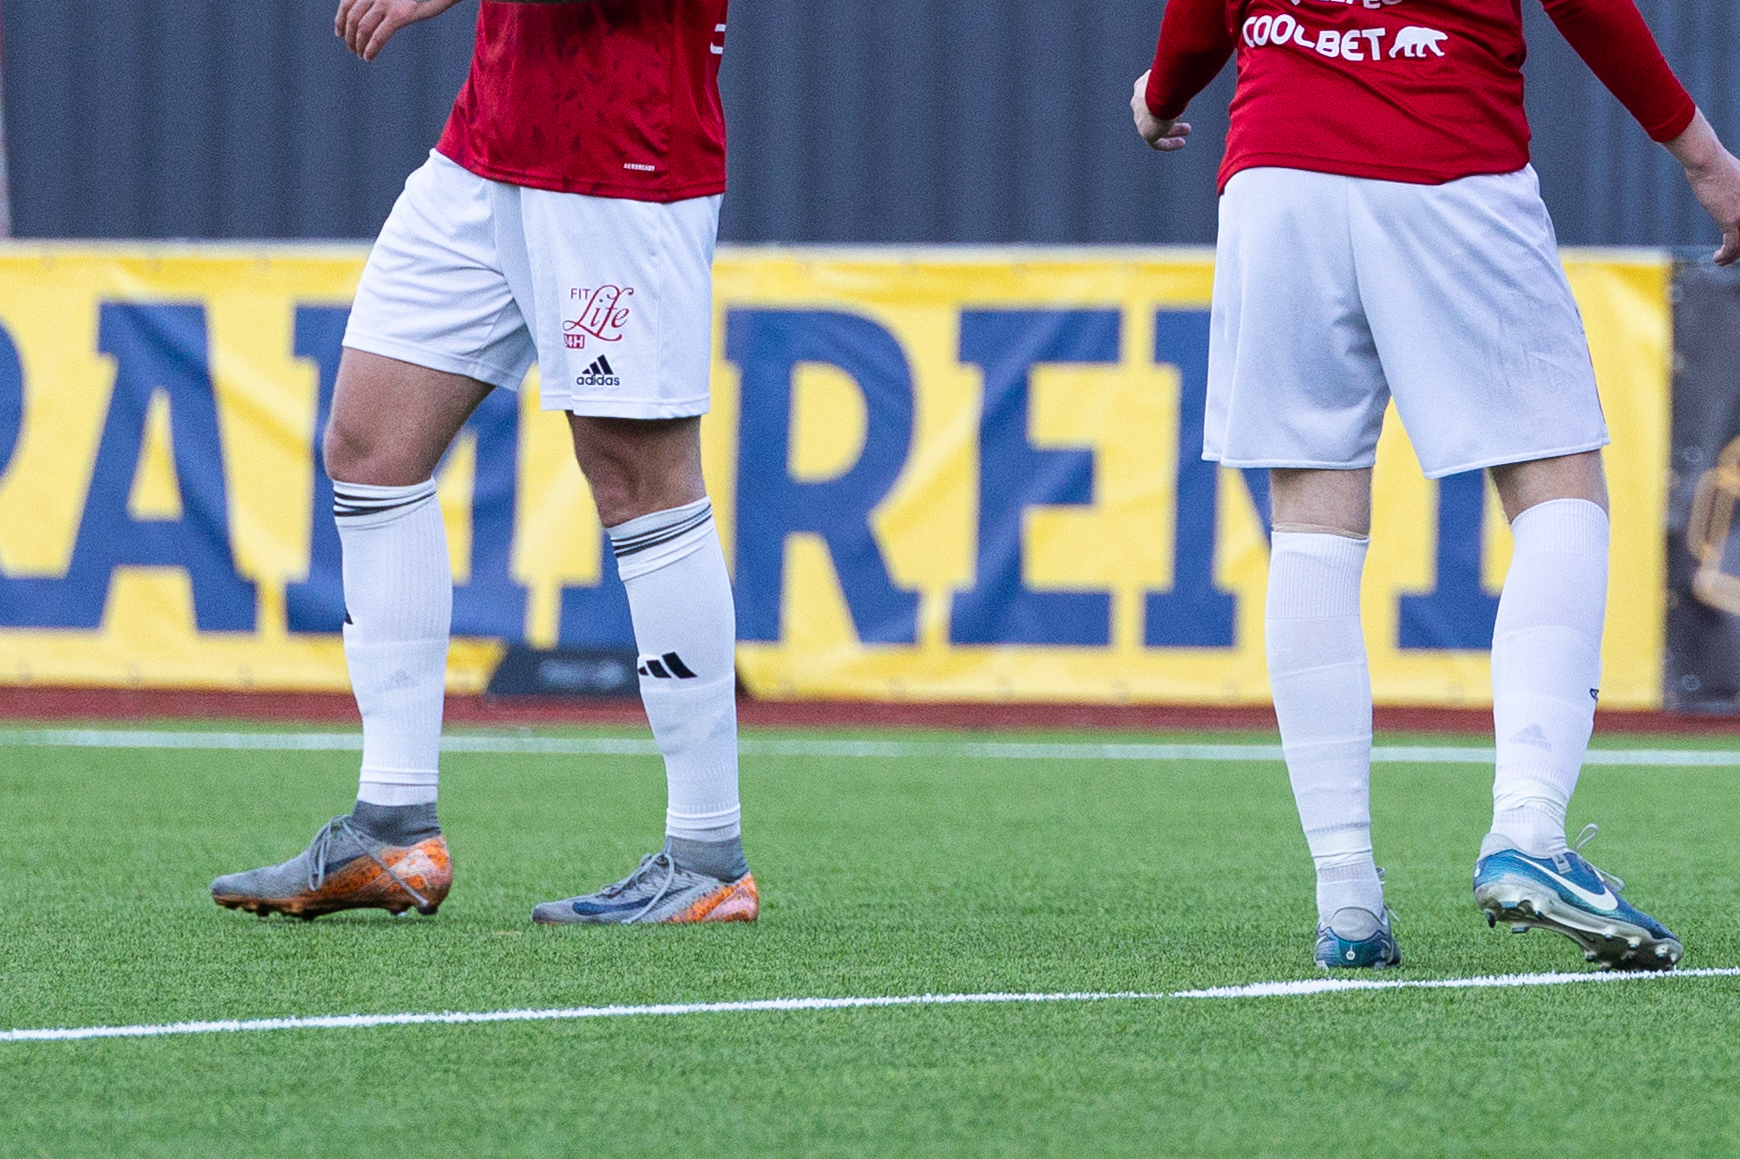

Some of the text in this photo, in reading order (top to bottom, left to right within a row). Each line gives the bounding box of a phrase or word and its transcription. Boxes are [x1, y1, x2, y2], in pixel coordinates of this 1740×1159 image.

[1242, 14, 1386, 61] COOLBET
[570, 288, 591, 300] FIT
[562, 284, 634, 342] Life
[576, 374, 620, 386] adidas
